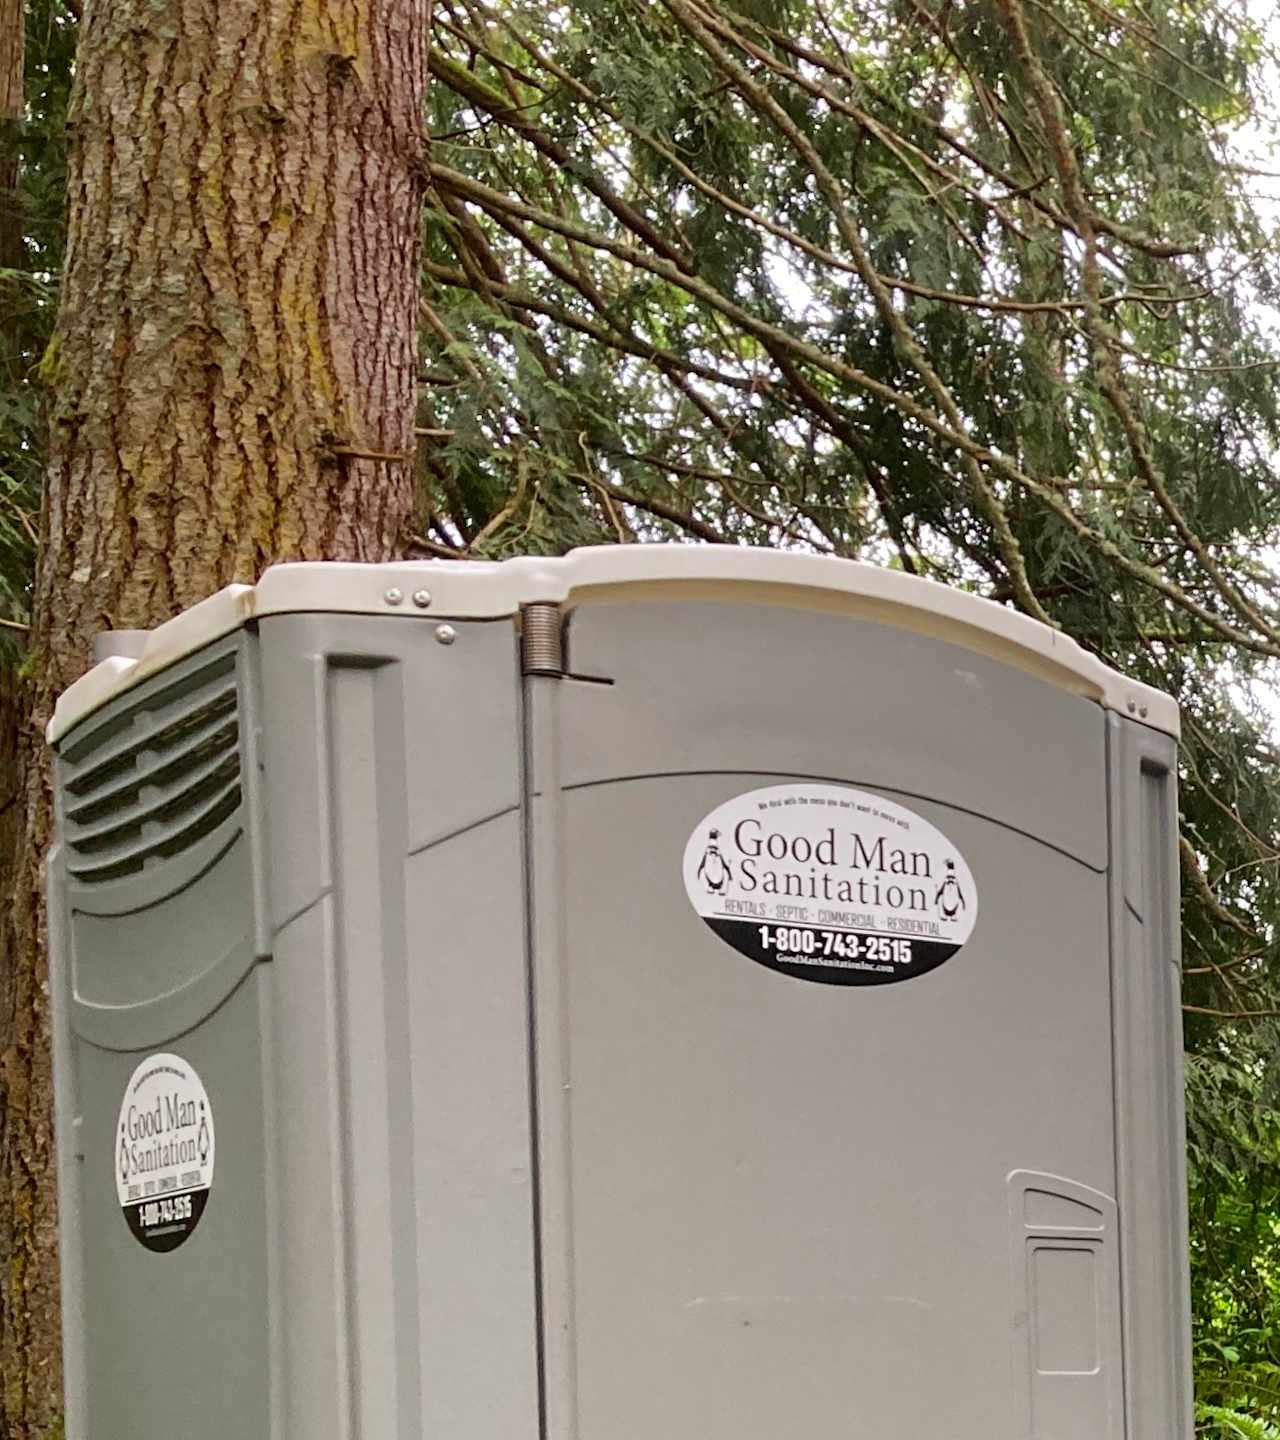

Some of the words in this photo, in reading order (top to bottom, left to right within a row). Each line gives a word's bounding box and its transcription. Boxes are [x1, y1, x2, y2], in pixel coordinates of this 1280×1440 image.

[735, 819, 837, 866] Good
[852, 833, 933, 878] Man
[740, 859, 928, 911] Sanitation
[724, 899, 766, 916] RENTALS
[776, 905, 808, 921] SEPTIC
[818, 909, 877, 928] COMMERCIAL
[887, 917, 940, 936] RESIDENTIAL
[758, 925, 912, 963] 1-800-743-2515
[128, 1095, 162, 1142] Good
[165, 1093, 197, 1132] Man
[130, 1133, 196, 1176] Sanitation
